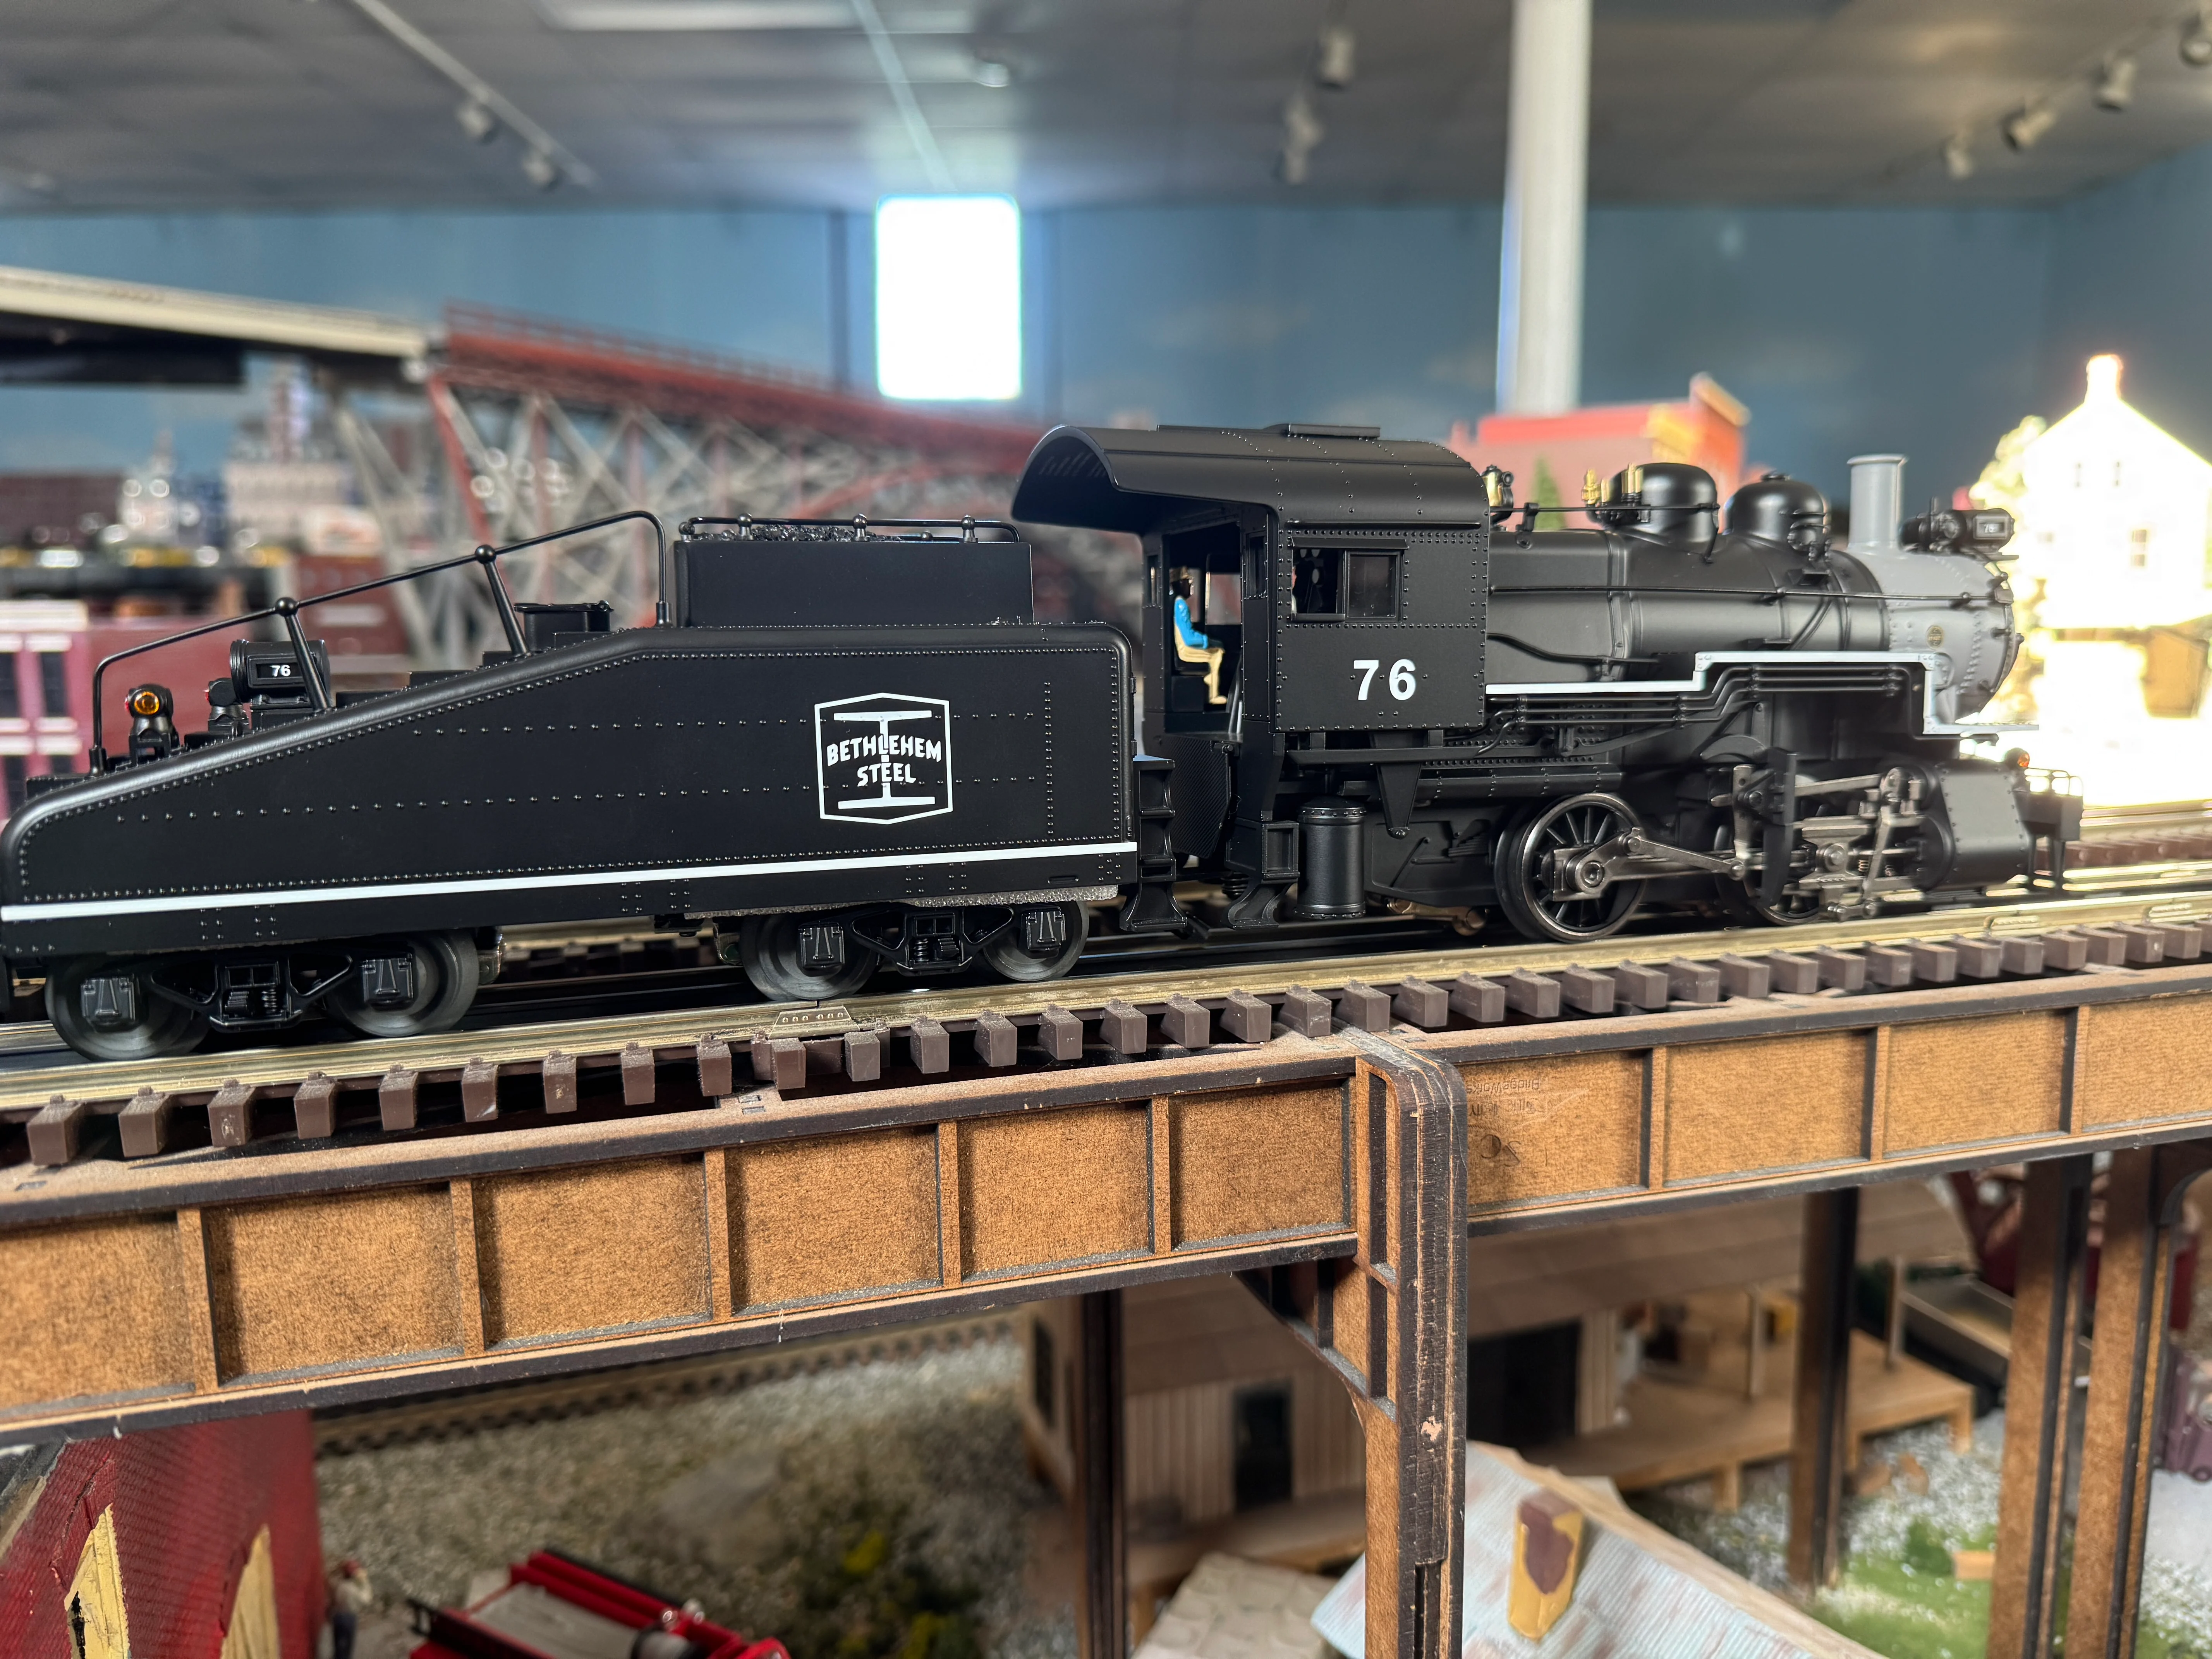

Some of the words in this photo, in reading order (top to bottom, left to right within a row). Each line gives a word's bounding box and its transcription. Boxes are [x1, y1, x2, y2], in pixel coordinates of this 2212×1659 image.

[270, 665, 291, 677] 76
[1353, 659, 1416, 701] 76
[827, 735, 941, 766] BETHLEHEM
[857, 763, 916, 787] STEEL
